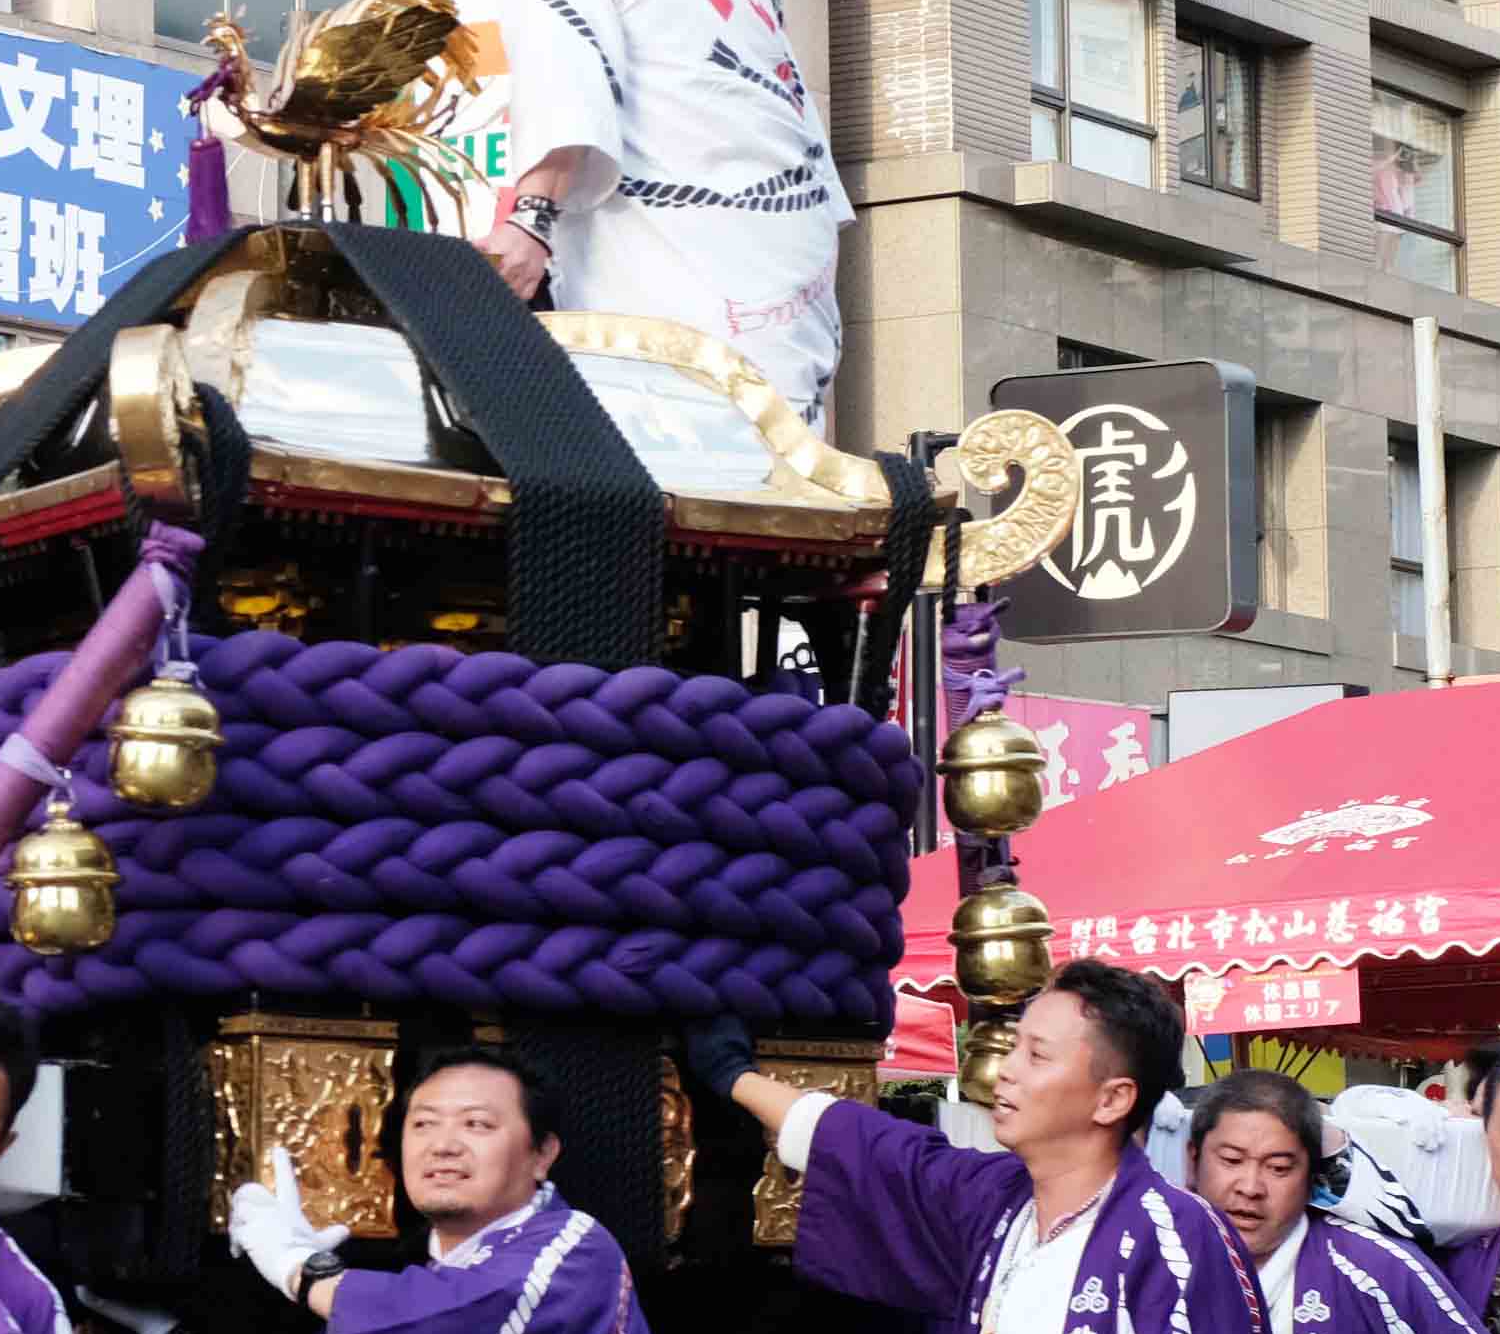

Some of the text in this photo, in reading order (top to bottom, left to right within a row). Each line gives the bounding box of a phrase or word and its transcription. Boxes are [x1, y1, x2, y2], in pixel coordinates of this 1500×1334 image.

[1130, 894, 1449, 956] 台北市松山慈祐宮
